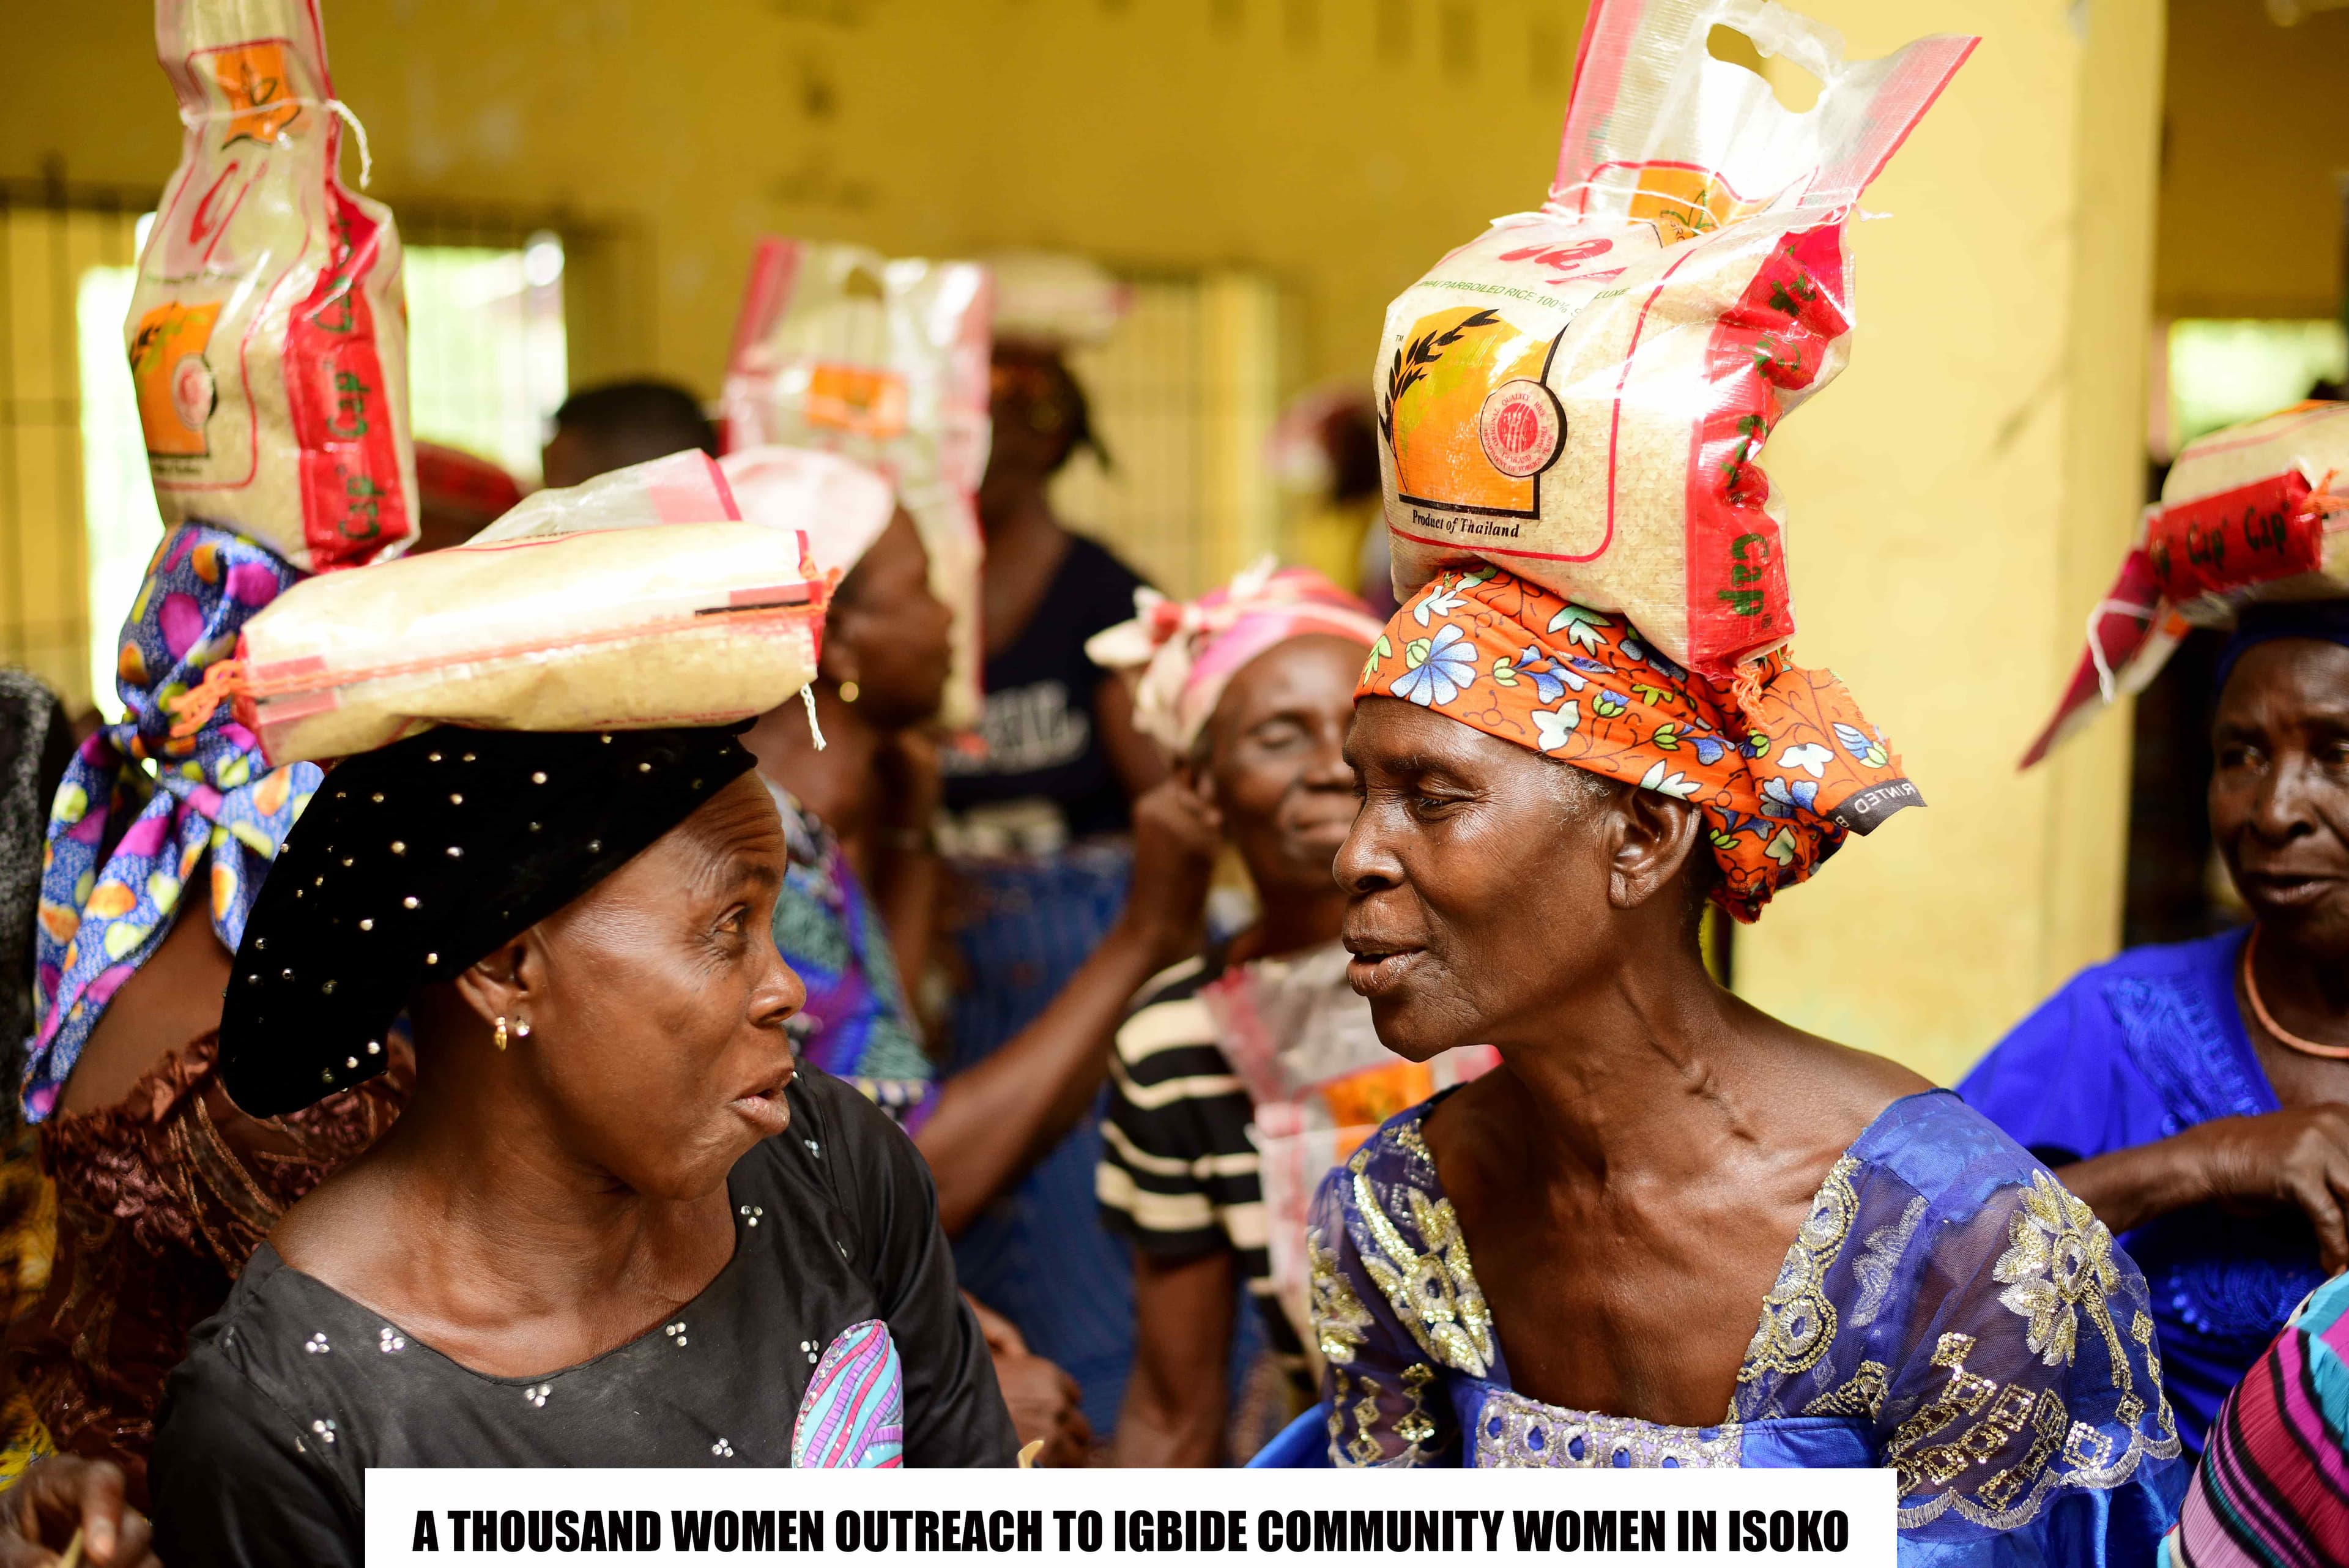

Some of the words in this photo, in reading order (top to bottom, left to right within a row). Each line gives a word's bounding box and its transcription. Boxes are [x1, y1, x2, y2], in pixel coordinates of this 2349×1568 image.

[1441, 281, 1505, 294] PARBOILED
[1504, 288, 1537, 300] RICE
[1537, 295, 1570, 313] 100%
[1501, 393, 1531, 406] QUALITY
[1534, 401, 1546, 417] RICE
[1519, 456, 1543, 472] FOREIGN
[1543, 434, 1553, 455] TRADE
[1412, 510, 1444, 529] Product
[1446, 518, 1458, 534] of
[1460, 518, 1520, 538] Thailand
